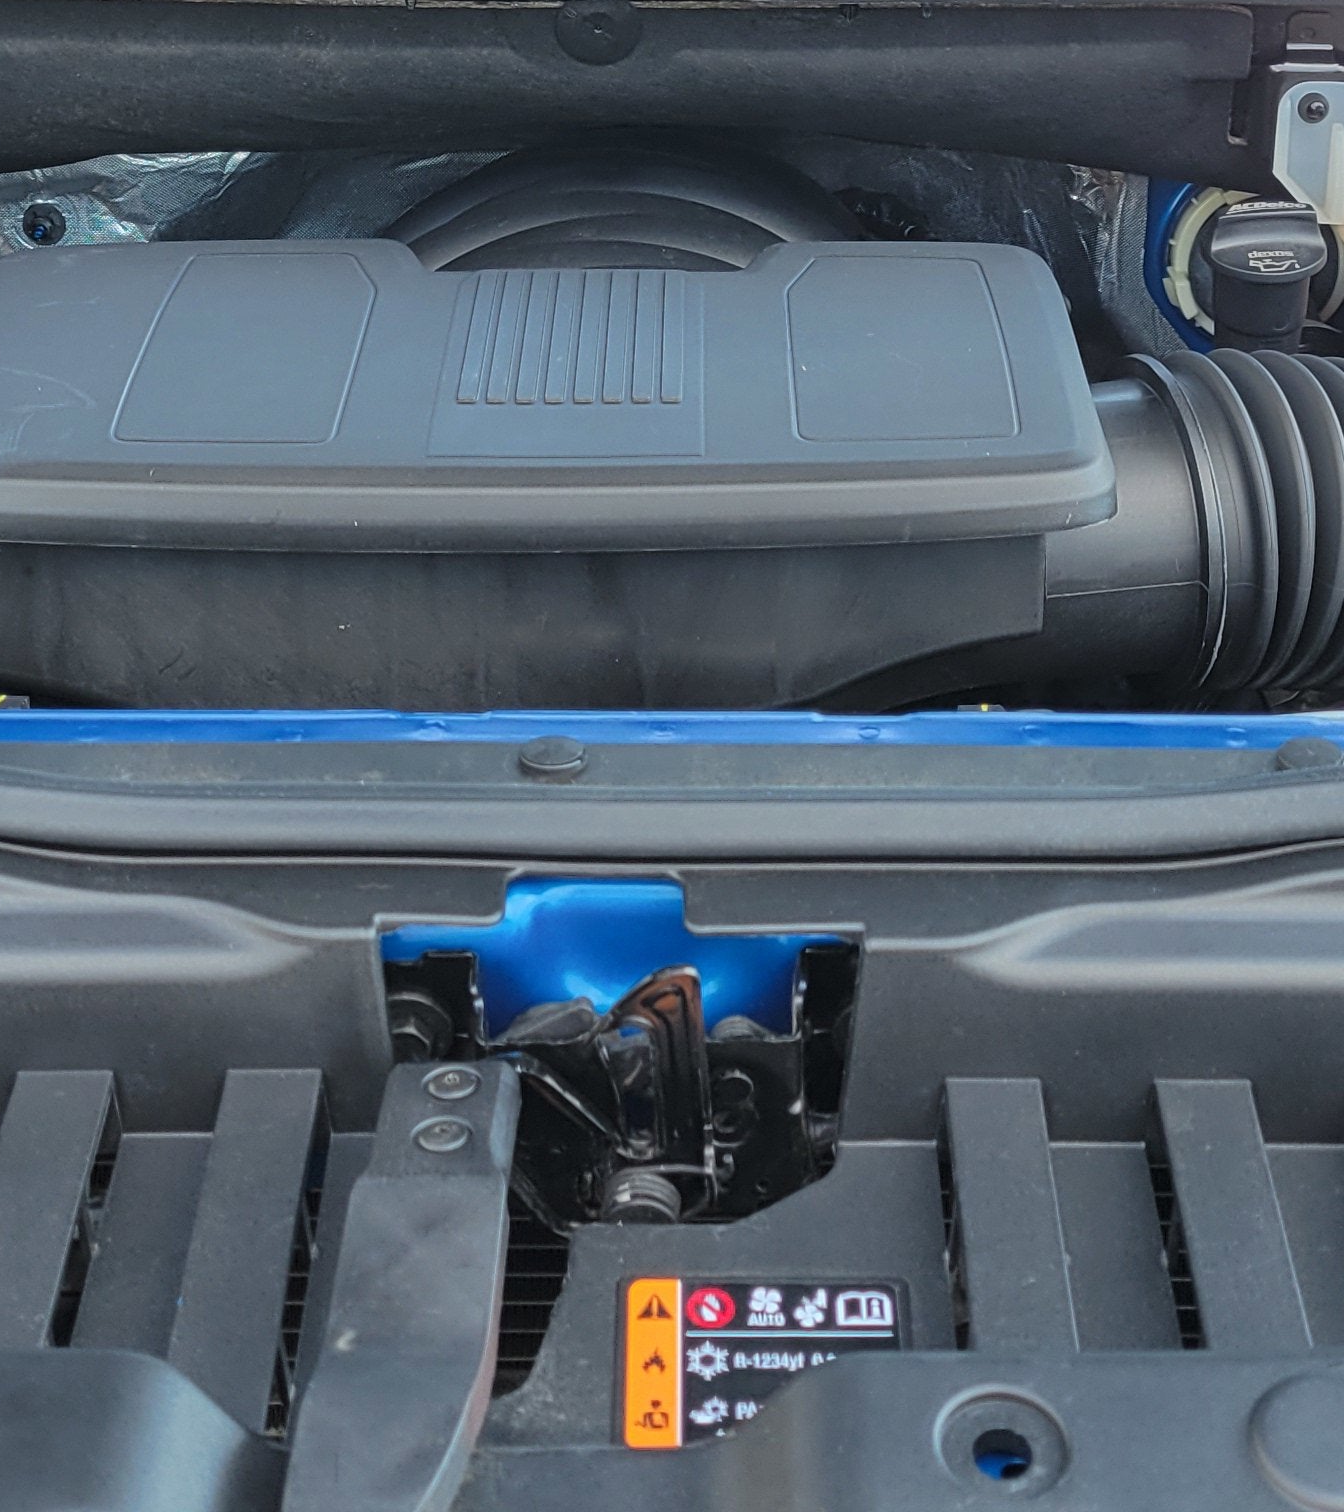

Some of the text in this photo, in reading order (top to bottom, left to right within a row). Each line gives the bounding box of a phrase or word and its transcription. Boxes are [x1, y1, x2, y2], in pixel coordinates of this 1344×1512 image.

[1227, 201, 1307, 212] ACDelco
[747, 1313, 786, 1327] AUTO
[732, 1352, 805, 1371] R-1234yf
[735, 1401, 765, 1420] PA
